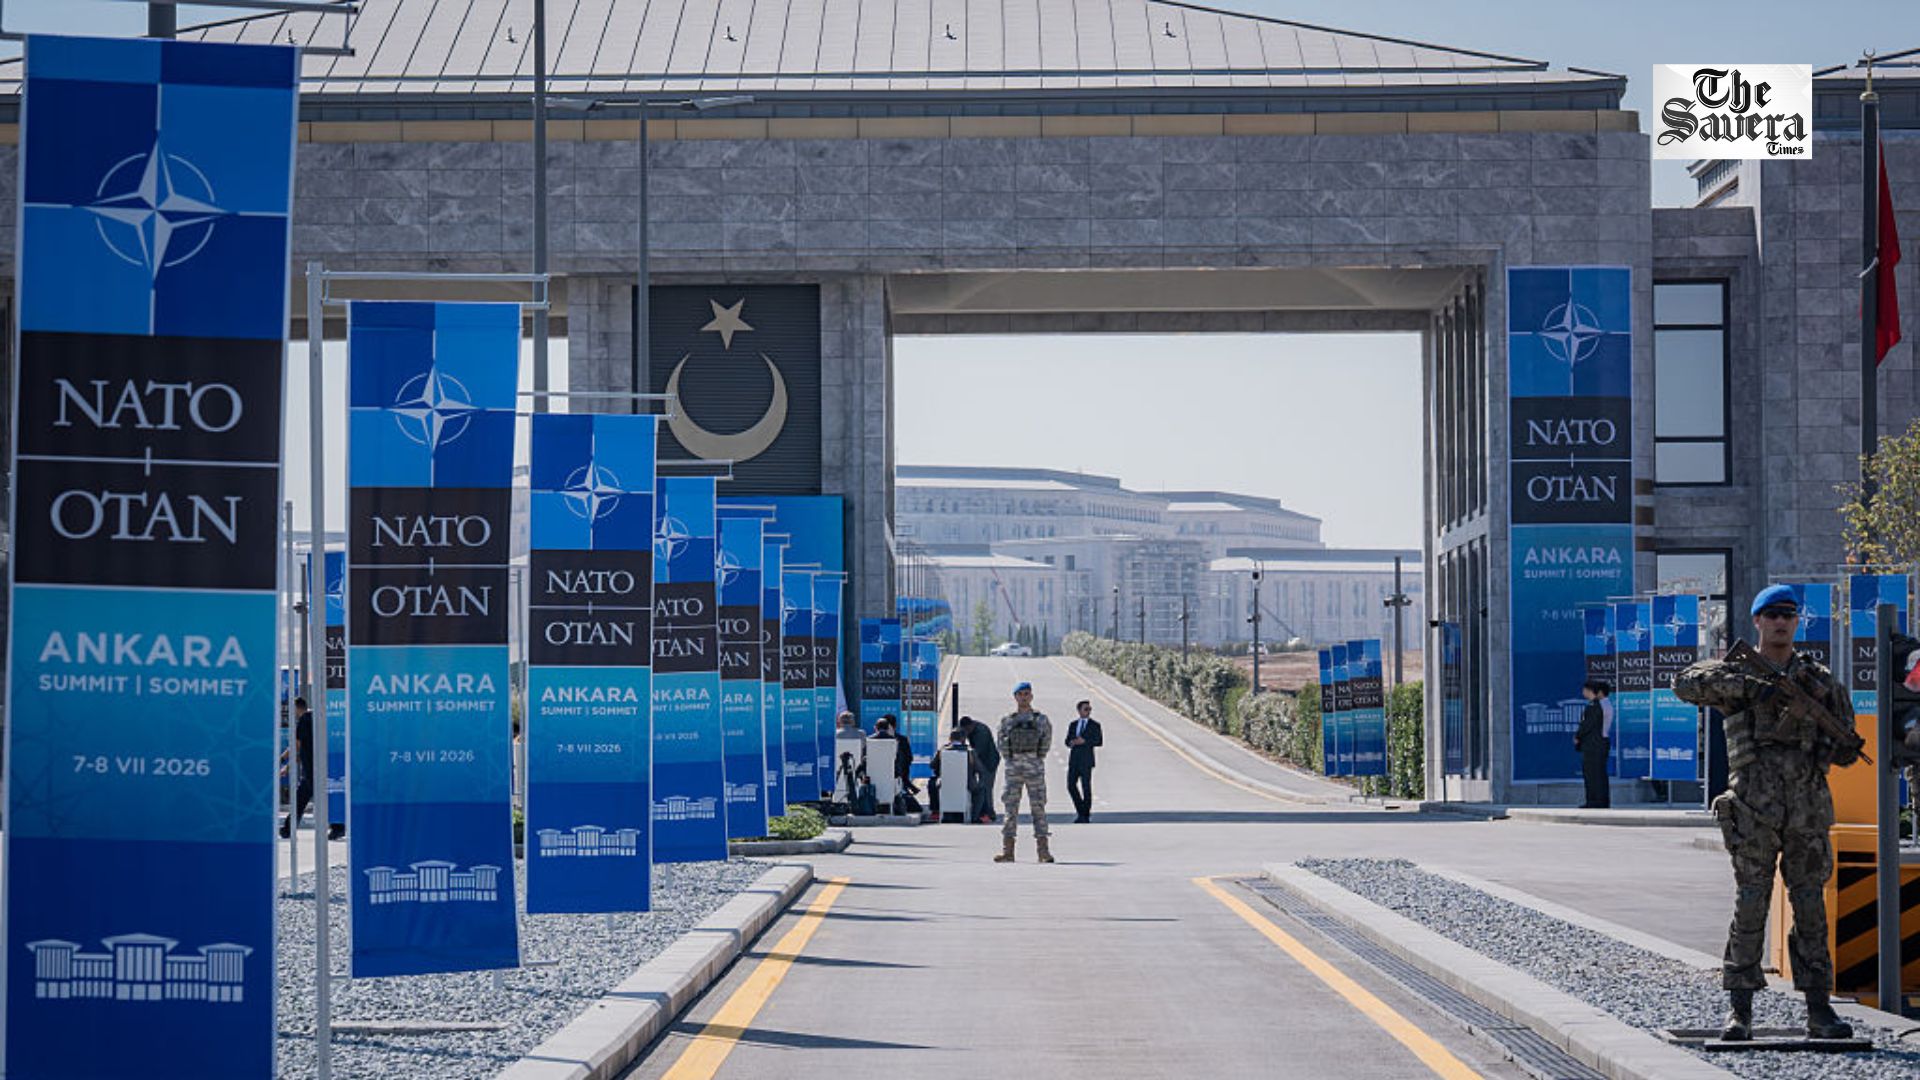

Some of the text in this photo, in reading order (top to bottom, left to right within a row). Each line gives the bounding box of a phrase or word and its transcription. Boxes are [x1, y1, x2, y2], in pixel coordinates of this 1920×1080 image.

[53, 378, 243, 432] NATO
[1526, 419, 1616, 445] NATO
[1527, 475, 1617, 502] OTAN
[51, 490, 243, 544] OTAN
[371, 515, 491, 547] NATO
[1524, 547, 1622, 564] ANKARA
[545, 570, 635, 594] NATO
[1524, 569, 1565, 579] SUMMIT
[1576, 569, 1621, 579] SOMMET
[371, 585, 492, 617] OTAN
[654, 598, 704, 617] ATO
[544, 621, 635, 645] OTAN
[720, 619, 750, 635] TO
[39, 631, 248, 668] ANKARA
[326, 637, 346, 650] NA
[653, 637, 705, 657] TAN
[720, 651, 750, 667] AN
[1658, 652, 1692, 663] NATO
[39, 674, 128, 693] SUMMIT
[149, 676, 247, 697] SOMMET
[367, 674, 496, 695] ANKARA
[541, 687, 639, 702] ANKARA
[653, 688, 711, 701] NKARA
[723, 693, 754, 704] ARA
[367, 701, 422, 712] SUMMIT
[436, 701, 496, 712] SOMMET
[541, 706, 582, 715] SUMMIT
[591, 706, 638, 715] SOMMET
[72, 755, 211, 777] 7-8 VII 2026
[390, 751, 475, 763] 7-8 VII 2026
